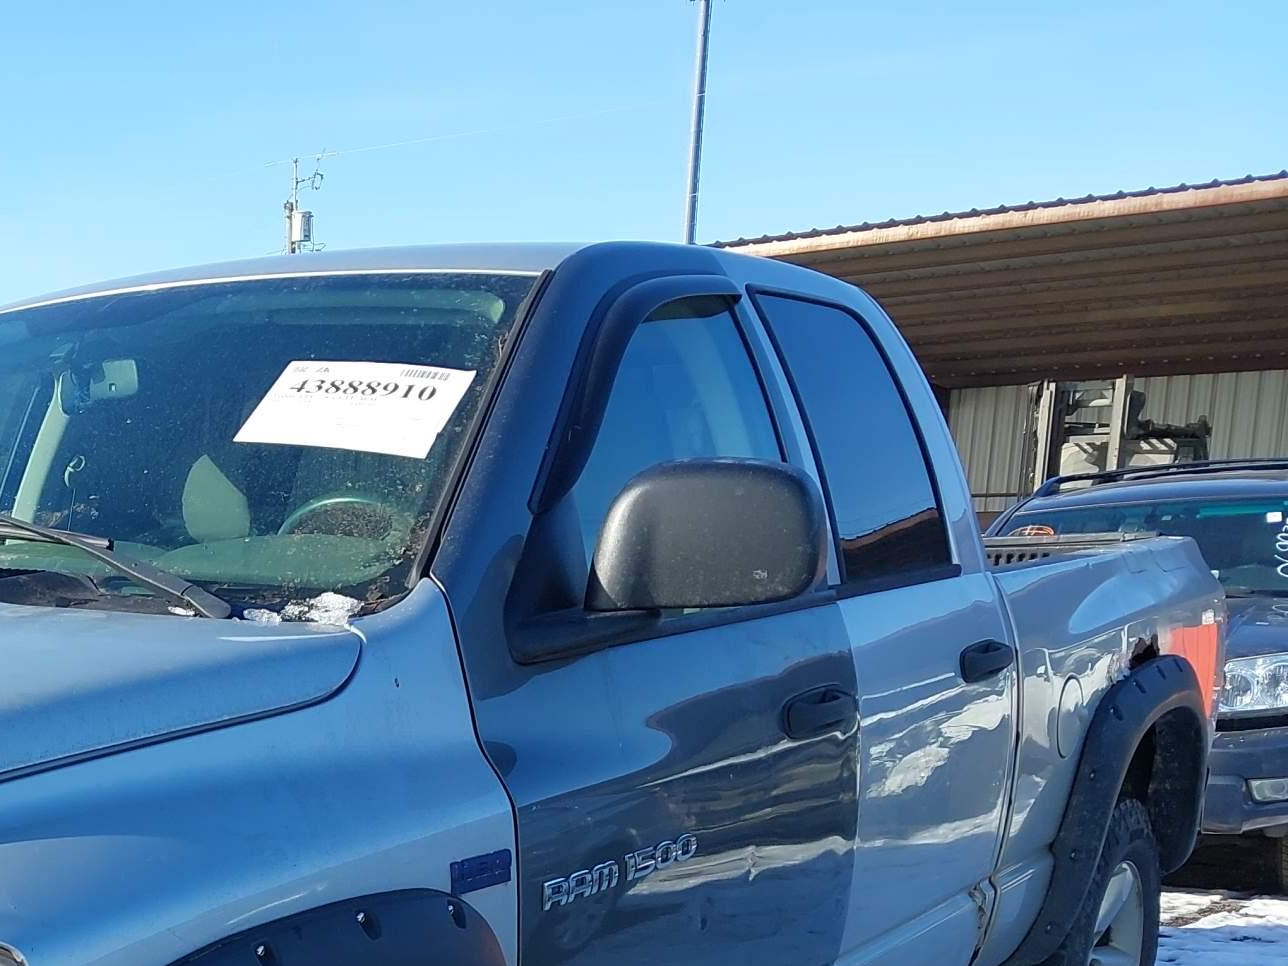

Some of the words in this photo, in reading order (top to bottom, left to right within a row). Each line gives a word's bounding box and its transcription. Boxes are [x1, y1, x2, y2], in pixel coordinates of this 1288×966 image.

[289, 378, 437, 401] 43888910
[542, 860, 619, 912] RAM
[624, 833, 697, 881] 1500
